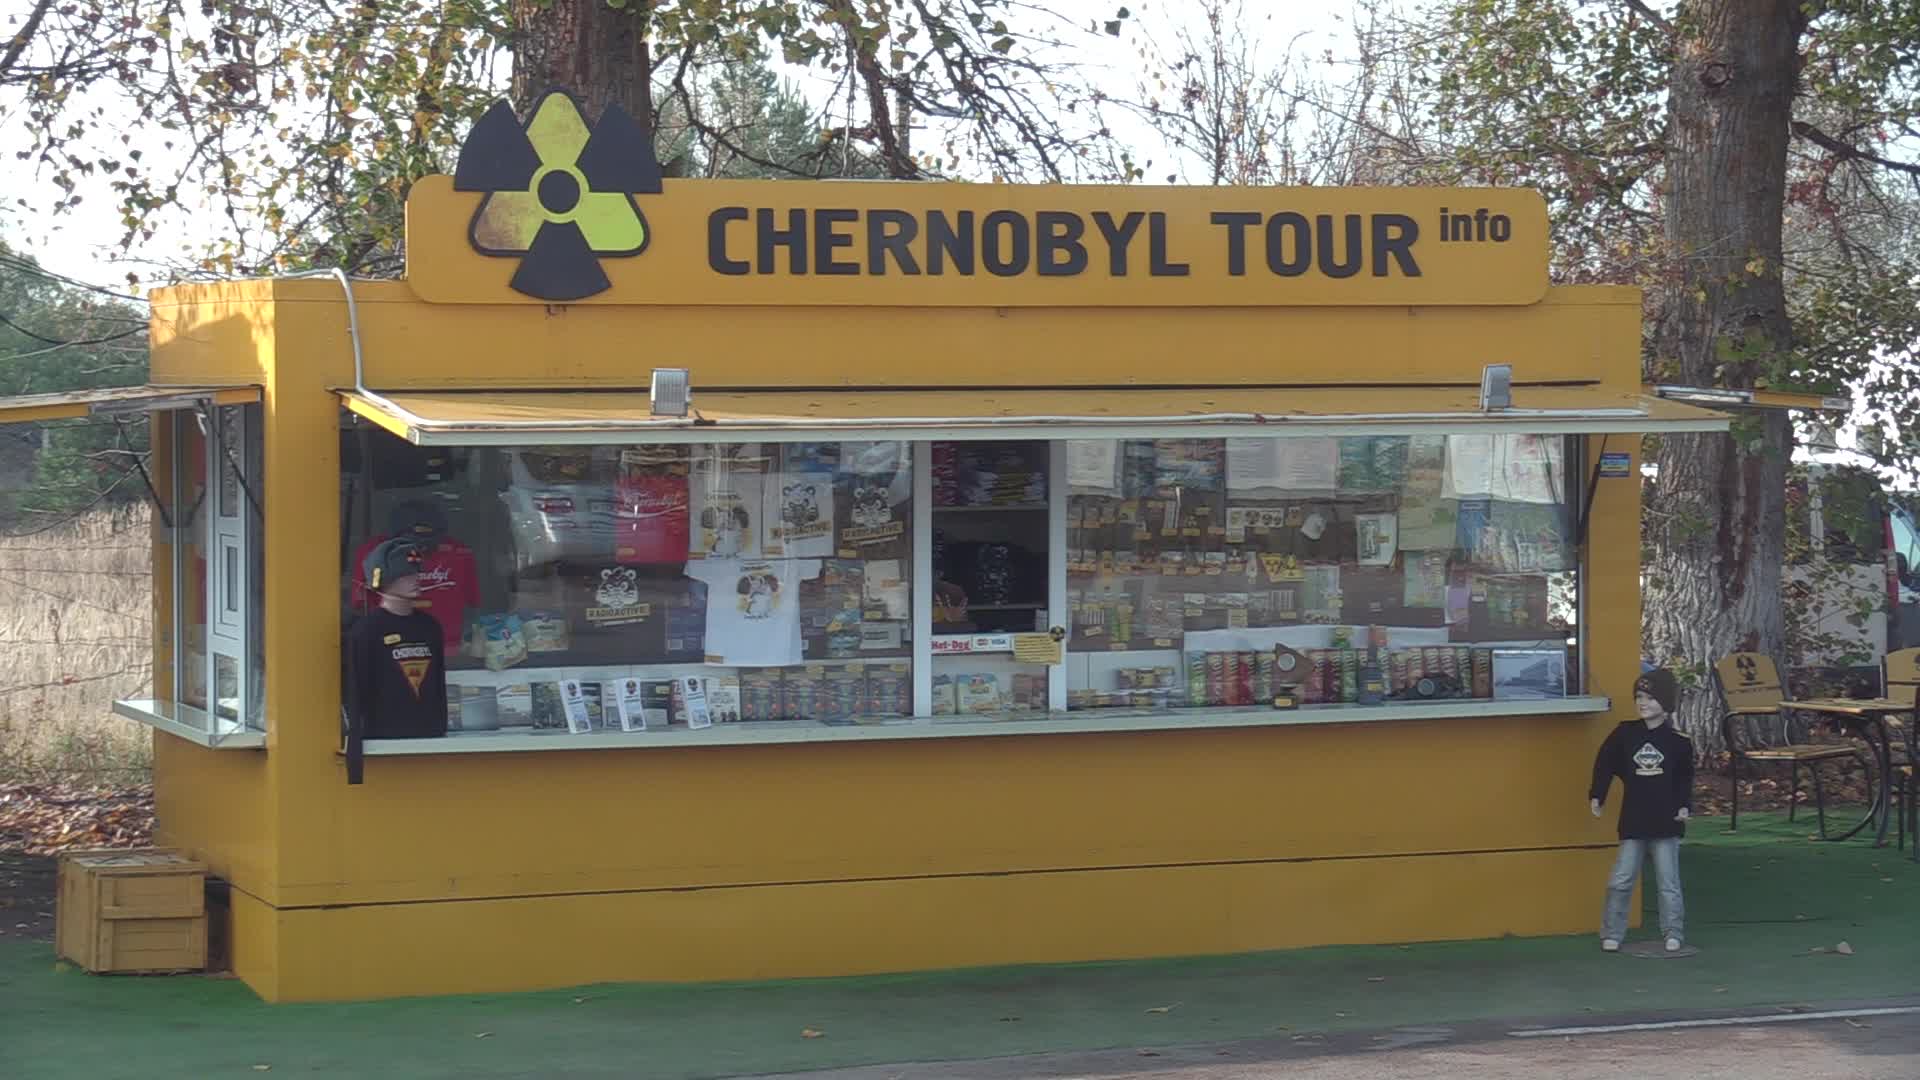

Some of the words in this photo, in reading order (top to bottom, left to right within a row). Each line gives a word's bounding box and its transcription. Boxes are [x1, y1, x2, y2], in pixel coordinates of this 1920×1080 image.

[707, 206, 1190, 277] CHERNOBYL
[1211, 211, 1421, 279] TOUR
[1440, 207, 1512, 242] info
